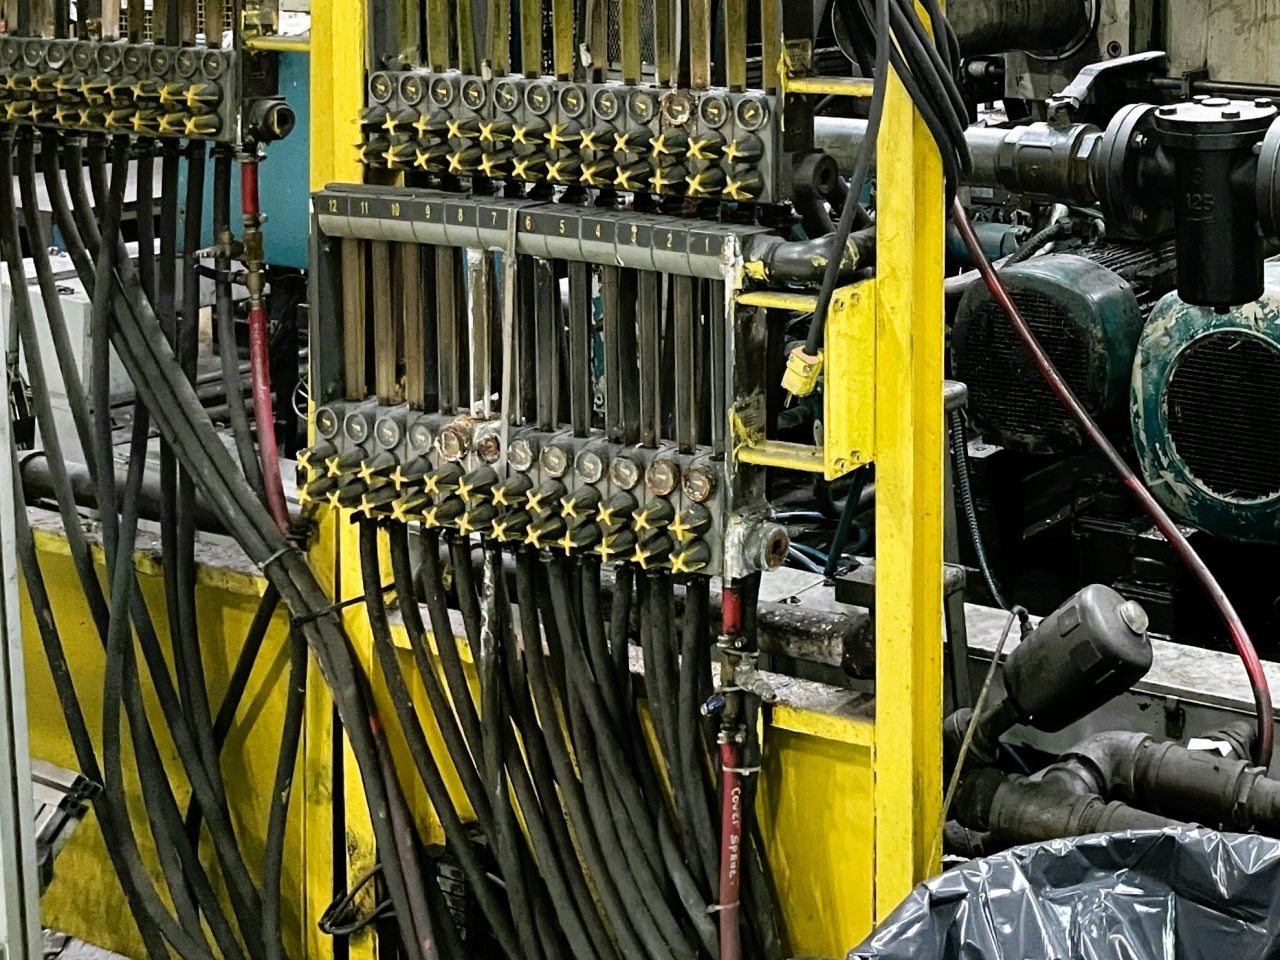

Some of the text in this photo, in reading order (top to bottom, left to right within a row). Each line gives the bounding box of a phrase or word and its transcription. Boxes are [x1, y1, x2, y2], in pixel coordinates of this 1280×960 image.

[1184, 193, 1214, 211] 125
[328, 199, 337, 212] 12
[360, 201, 368, 215] 11
[391, 202, 400, 216] 10
[425, 204, 431, 218] 9
[457, 208, 463, 222] 8
[491, 211, 497, 225] 7
[525, 216, 531, 230] 6
[559, 220, 565, 234] 5
[595, 224, 600, 238] 4
[667, 231, 673, 248] 2
[730, 787, 741, 825] Cover
